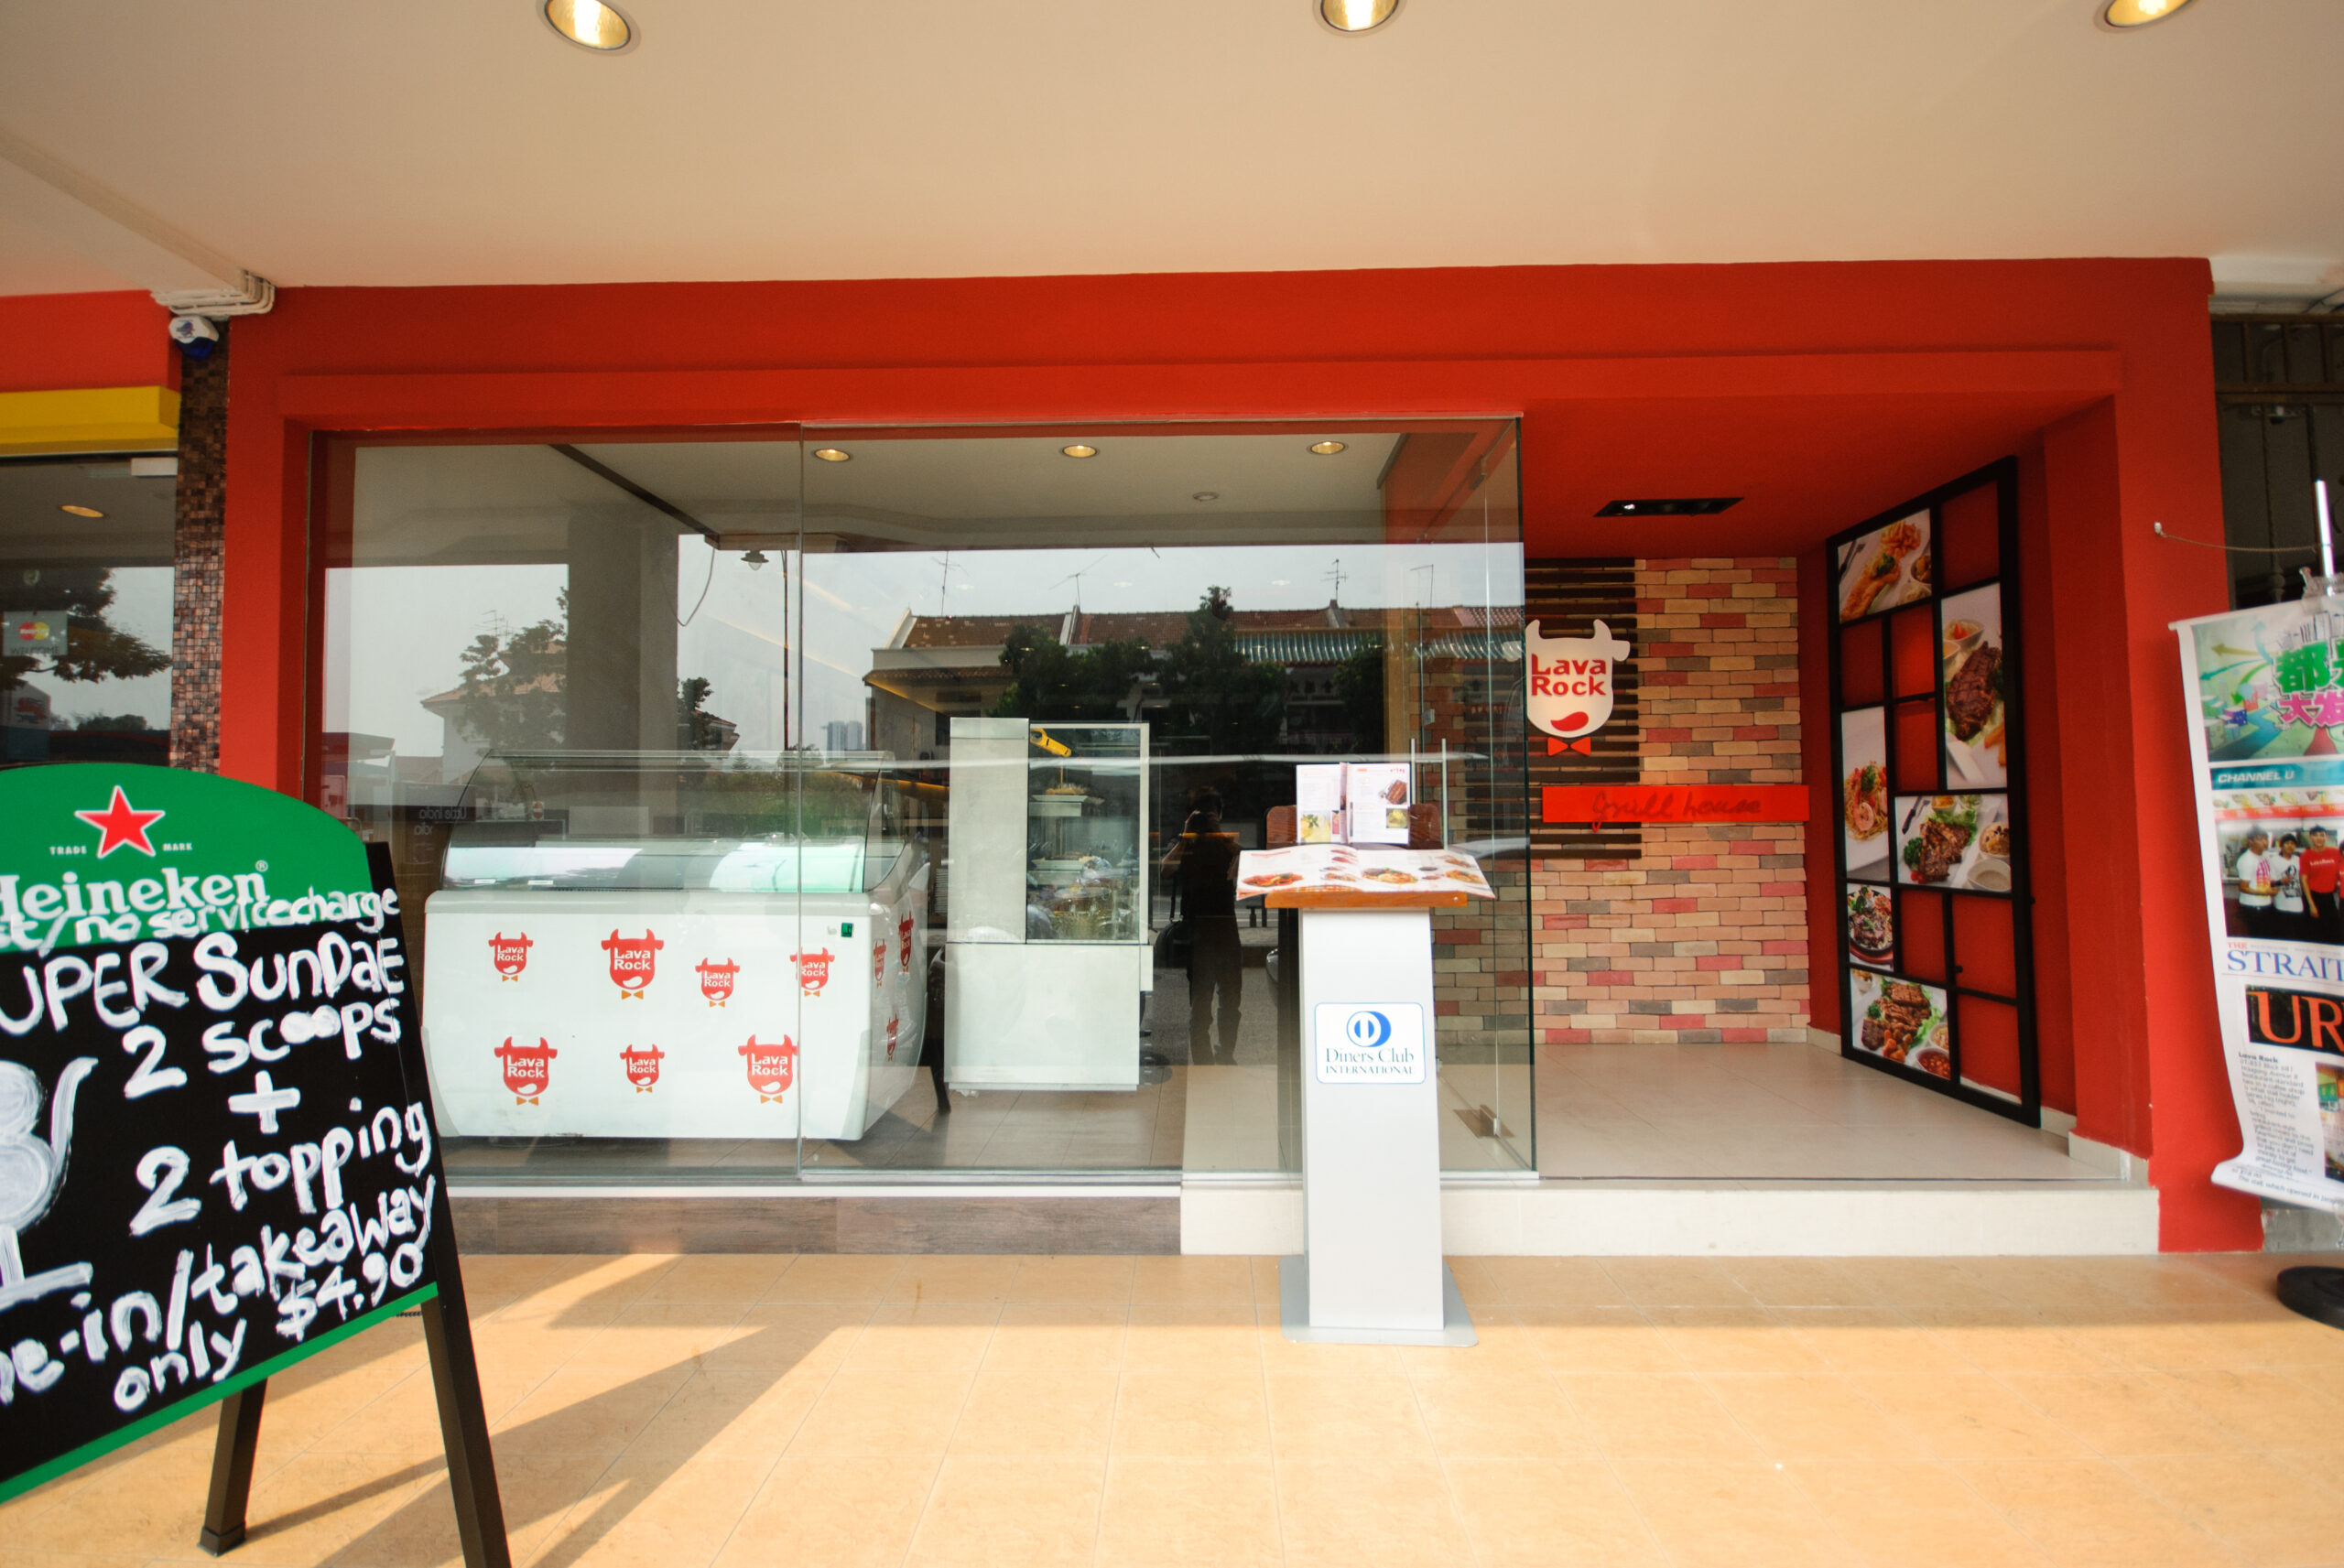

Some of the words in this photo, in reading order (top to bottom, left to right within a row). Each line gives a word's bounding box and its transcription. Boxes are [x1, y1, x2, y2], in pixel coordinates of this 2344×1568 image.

[1531, 654, 1607, 676] Lava
[2275, 641, 2344, 693] 都
[1531, 676, 1607, 697] Rock
[2218, 771, 2281, 784] CHANNEL
[2284, 770, 2295, 780] U
[1683, 791, 1761, 817] house
[49, 845, 87, 855] TRADE
[162, 842, 193, 851] MARK
[497, 945, 524, 954] Lava
[613, 947, 651, 959] Lava
[497, 953, 524, 961] Rock
[613, 959, 651, 970] Rock
[2228, 950, 2344, 981] STRAIT
[704, 971, 731, 979] Lava
[704, 979, 731, 988] Rock
[2249, 991, 2344, 1052] UR
[123, 1025, 188, 1098] 2
[507, 1054, 545, 1066] Lava
[629, 1057, 656, 1065] Lava
[751, 1053, 788, 1065] Lava
[1326, 1048, 1373, 1063] Diners
[1378, 1048, 1415, 1063] Club
[507, 1066, 545, 1077] Rock
[629, 1065, 657, 1073] Rock
[751, 1065, 788, 1076] Rock
[1326, 1065, 1413, 1075] INTERNATIONAL
[130, 1146, 201, 1237] 2
[210, 1097, 432, 1213] topping
[114, 1318, 246, 1411] only
[277, 1242, 423, 1341] $4.90
